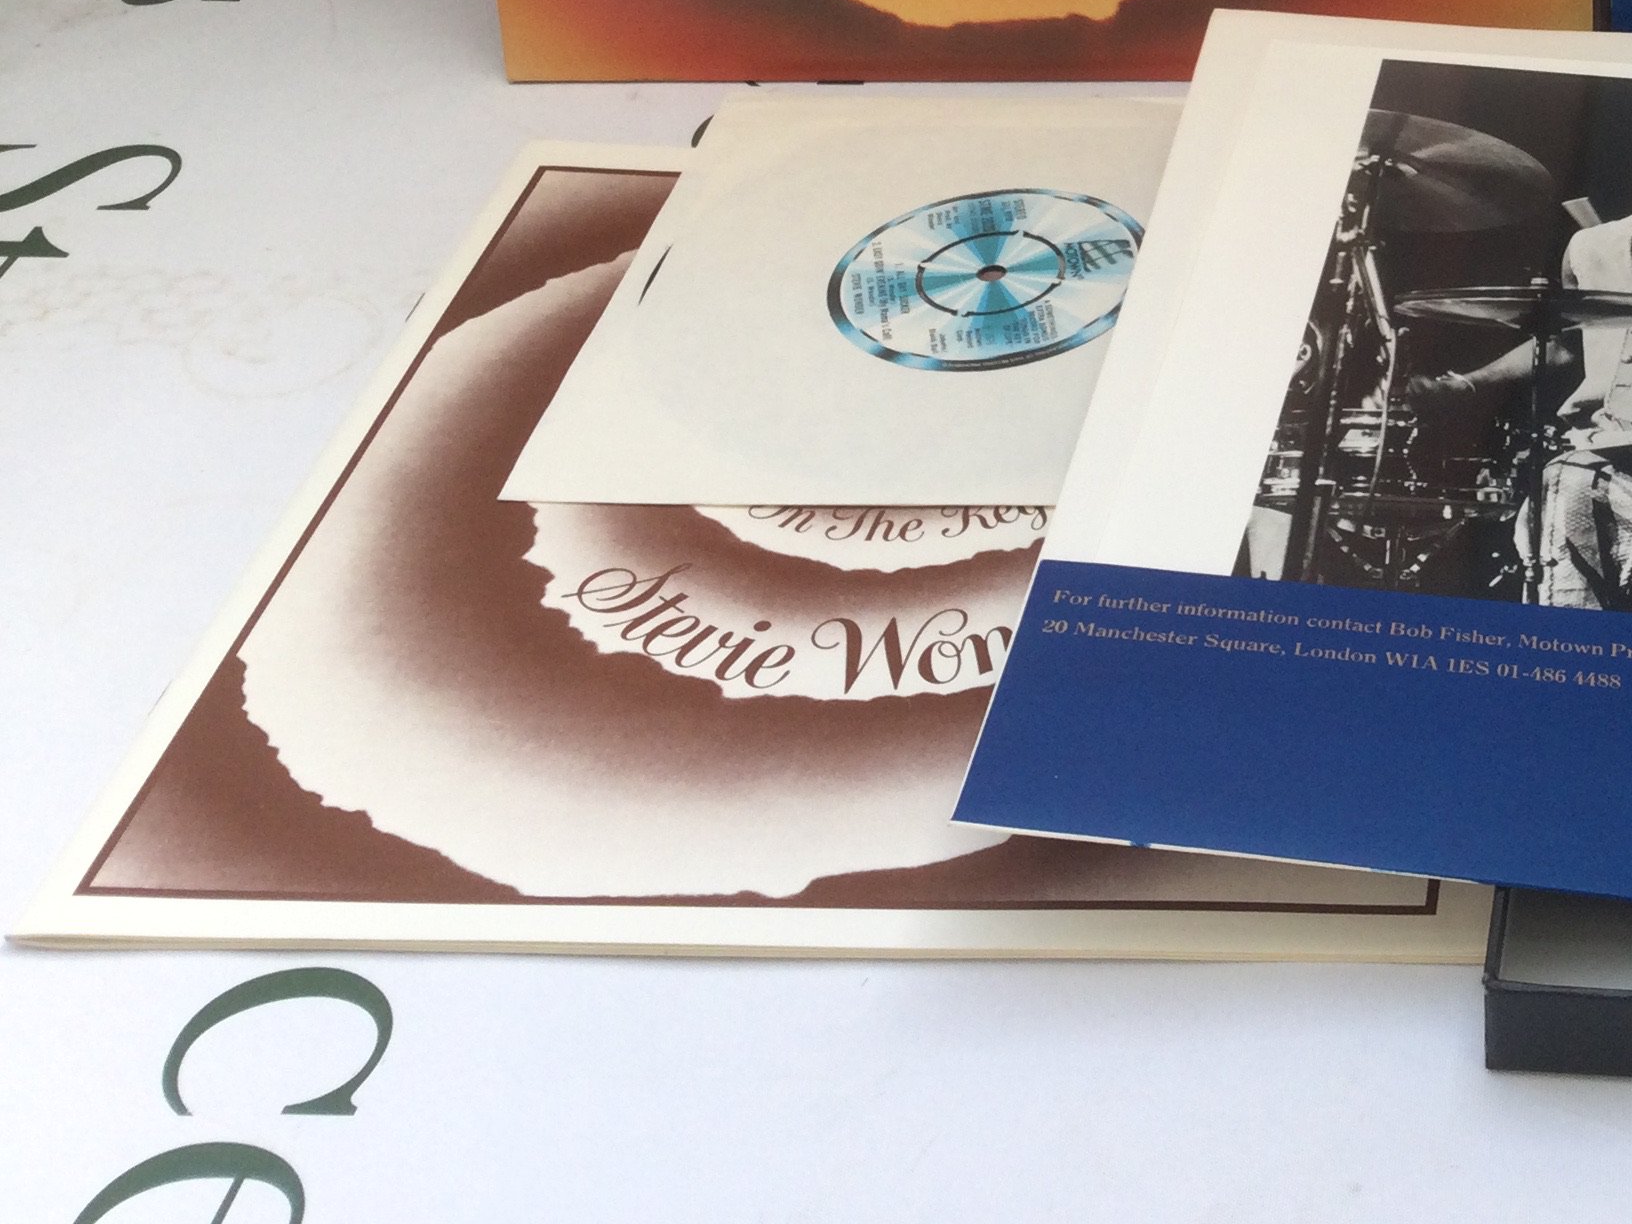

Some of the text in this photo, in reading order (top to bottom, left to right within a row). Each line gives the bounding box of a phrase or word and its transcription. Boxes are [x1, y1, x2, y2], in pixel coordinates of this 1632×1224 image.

[825, 505, 925, 543] The
[561, 562, 797, 689] Stevie
[1041, 619, 1623, 689] 20 Manchester Square, London W1A 1ES 01-486 4488
[1052, 589, 1093, 606] For
[1098, 594, 1172, 614] further
[1176, 602, 1300, 626] information
[1306, 616, 1382, 634] contact
[1389, 621, 1433, 639] Bob
[1439, 626, 1512, 648] Fisher,
[1518, 634, 1603, 656] Motown
